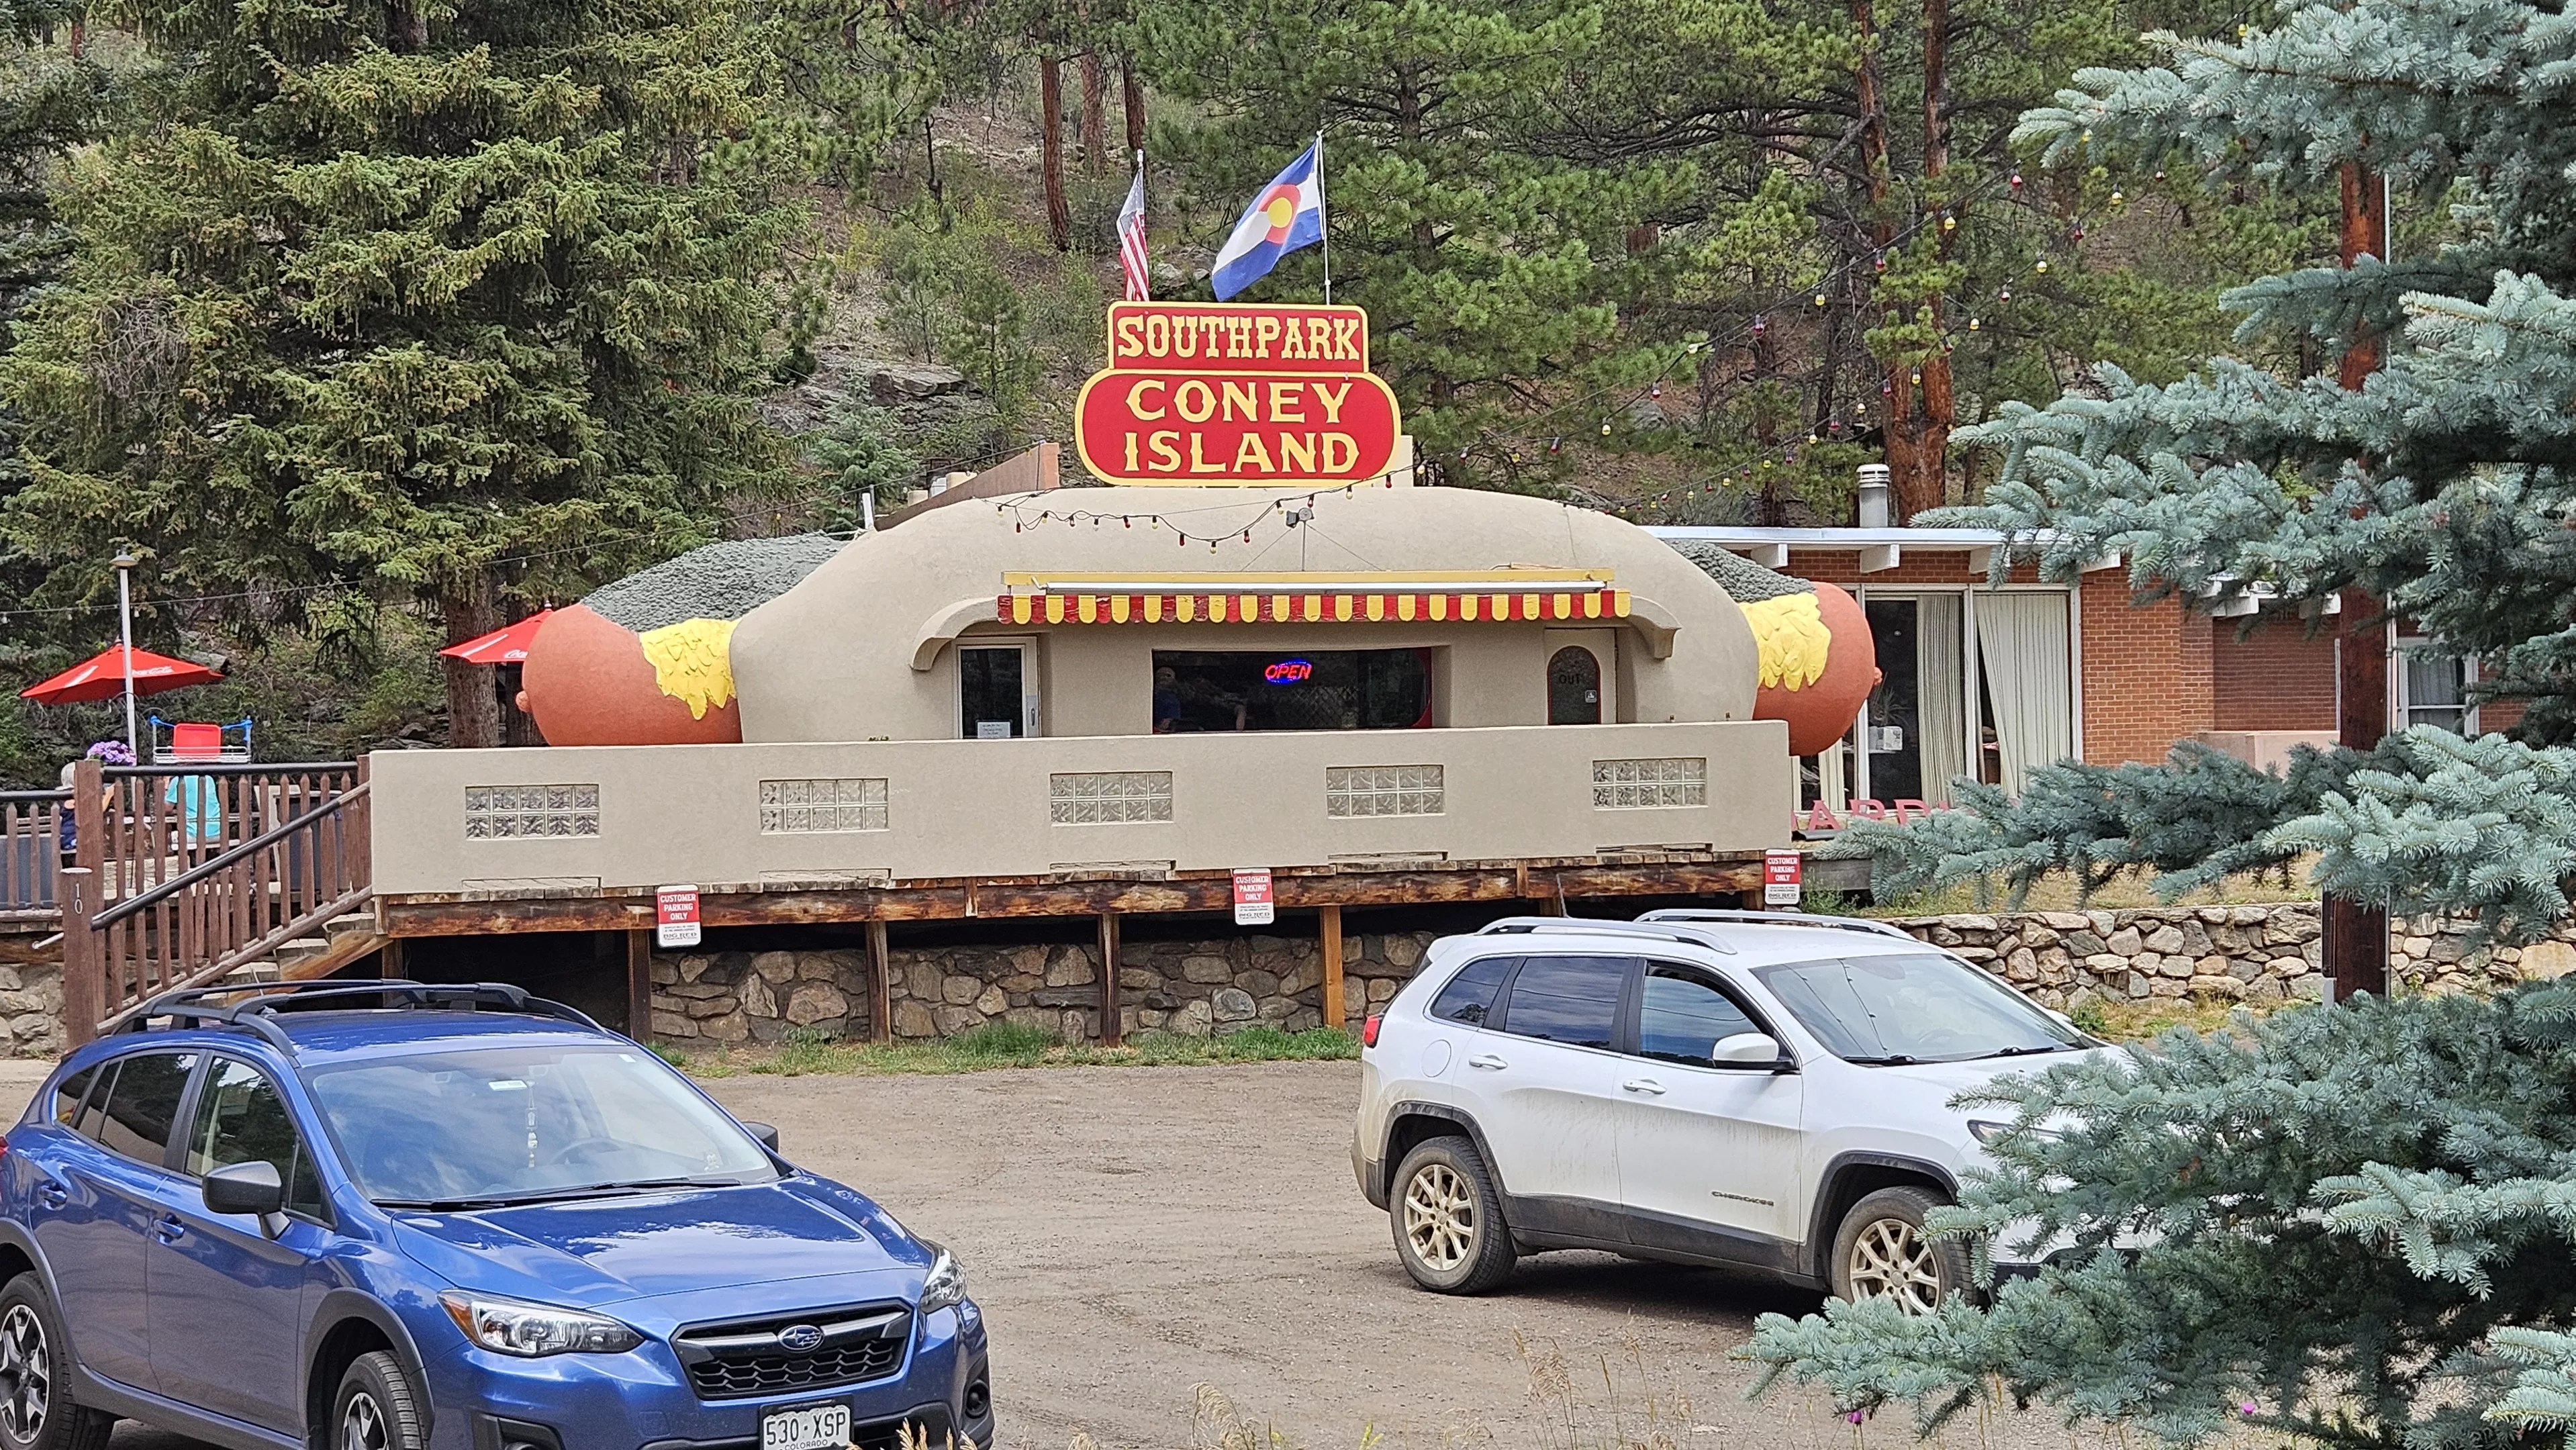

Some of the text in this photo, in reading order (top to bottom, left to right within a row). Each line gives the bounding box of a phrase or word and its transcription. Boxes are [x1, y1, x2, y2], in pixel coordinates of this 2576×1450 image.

[1117, 313, 1360, 360] SOUTHPARK
[1125, 379, 1353, 424] CONEY
[1125, 431, 1360, 473] ISLAND
[1265, 664, 1313, 679] OPEN
[1558, 673, 1580, 685] OUT
[1235, 875, 1270, 884] CUSTOMER
[1239, 884, 1268, 893] PARKING
[660, 893, 696, 903] CUSTOMER
[1245, 893, 1262, 901] ONLY
[663, 903, 694, 912] PARKING
[670, 912, 688, 921] ONLY
[784, 1439, 828, 1450] COLORADO
